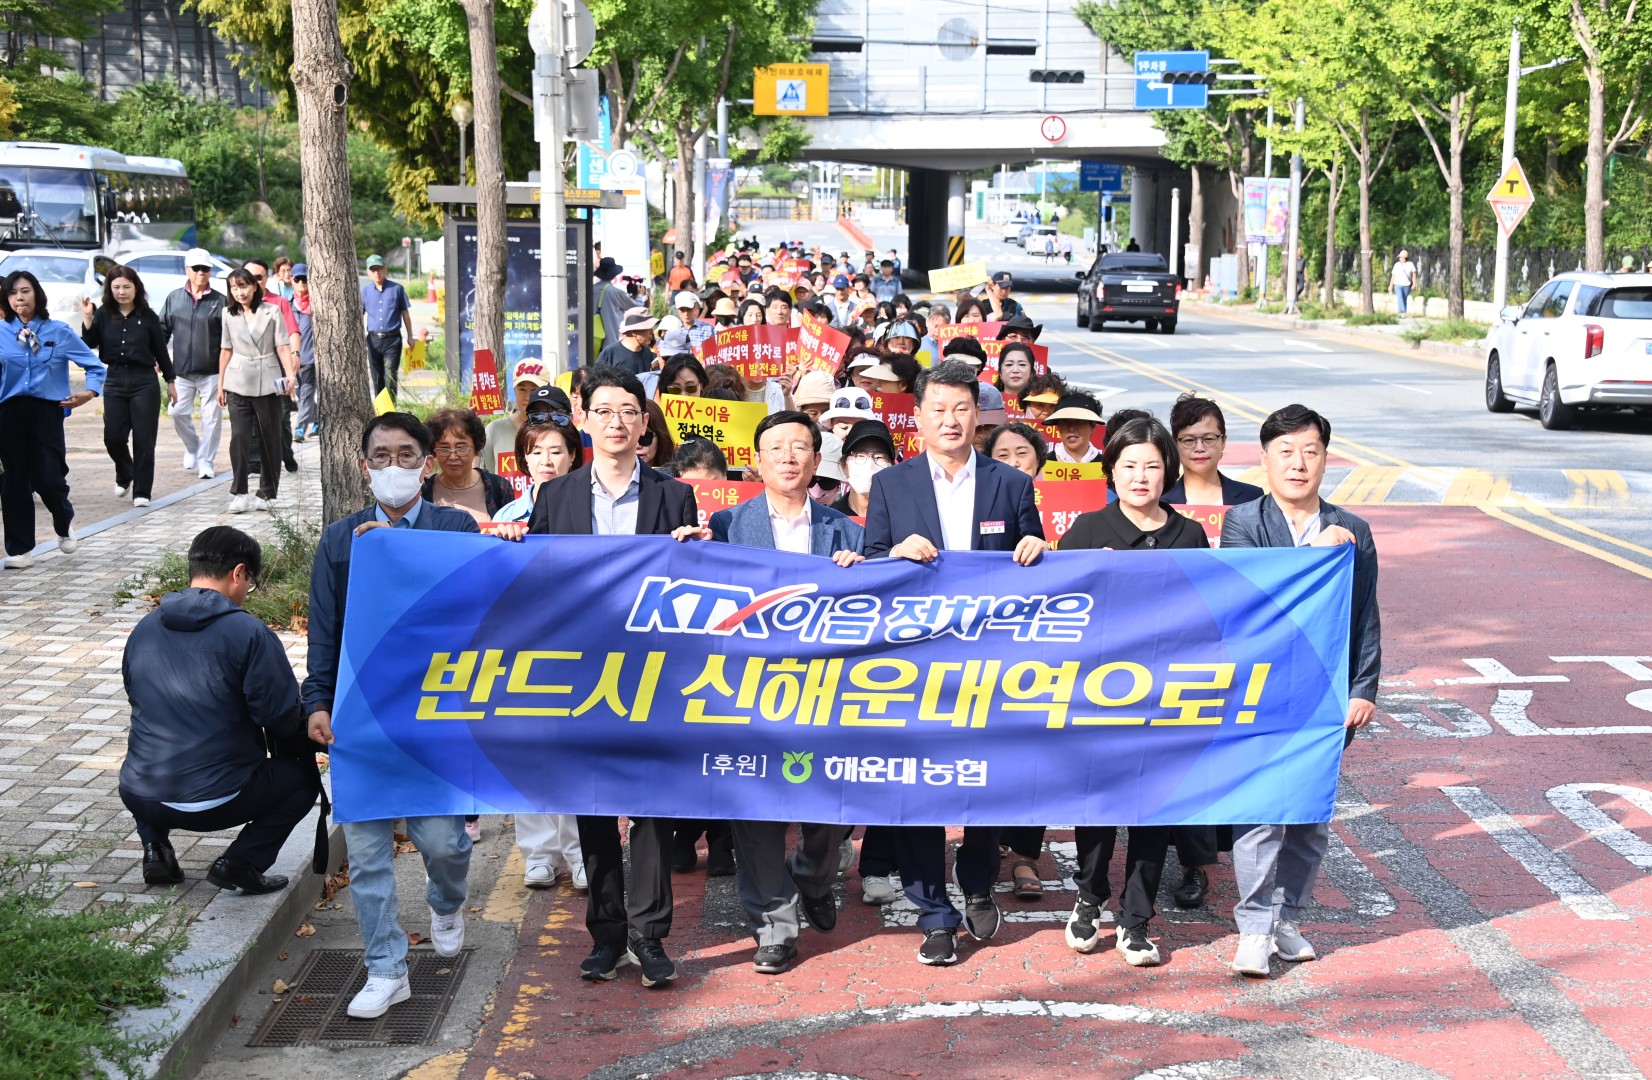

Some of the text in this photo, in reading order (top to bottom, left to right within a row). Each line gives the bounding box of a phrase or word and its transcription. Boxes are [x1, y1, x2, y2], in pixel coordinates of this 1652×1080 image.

[717, 329, 749, 346] KTX-이음
[939, 325, 979, 338] KTX-이음
[752, 343, 783, 359] 정차로
[478, 371, 497, 391] 정차로
[665, 399, 730, 423] KTX-이음
[887, 412, 915, 430] 정차로
[677, 422, 725, 443] 정차역은
[884, 592, 1094, 644] 정차역은
[415, 648, 666, 723] 반드시
[680, 653, 1272, 729] 신해운대역으로!
[702, 752, 767, 779] [후원]
